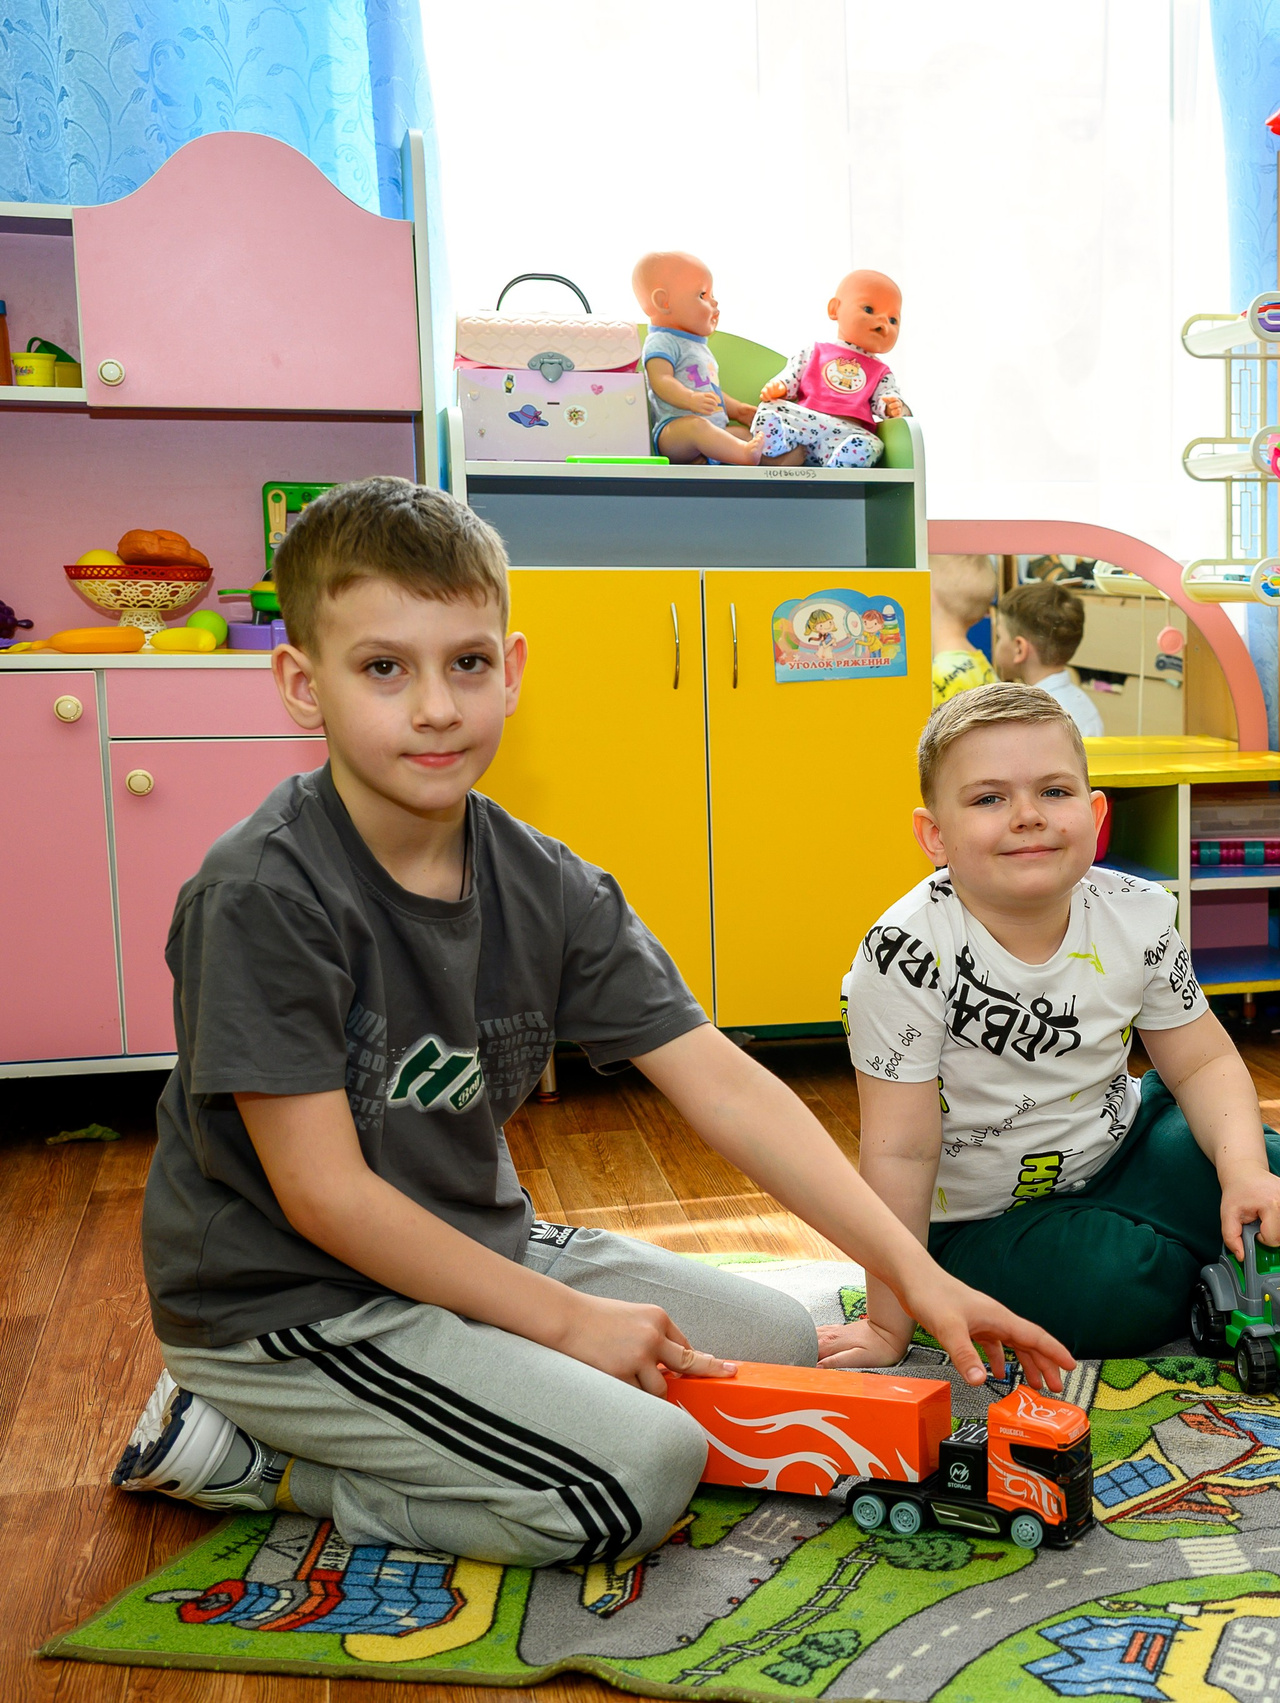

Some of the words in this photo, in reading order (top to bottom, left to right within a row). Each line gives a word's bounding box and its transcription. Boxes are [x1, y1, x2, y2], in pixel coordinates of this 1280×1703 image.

[789, 660, 833, 670] УГОЛОК
[836, 657, 891, 668] РЯЖЕНИЯ
[884, 1047, 905, 1080] good
[898, 1023, 922, 1047] day
[865, 1055, 884, 1072] be
[1014, 1094, 1037, 1115] day
[947, 1481, 972, 1491] STORAGE
[1217, 1623, 1277, 1692] BUS
